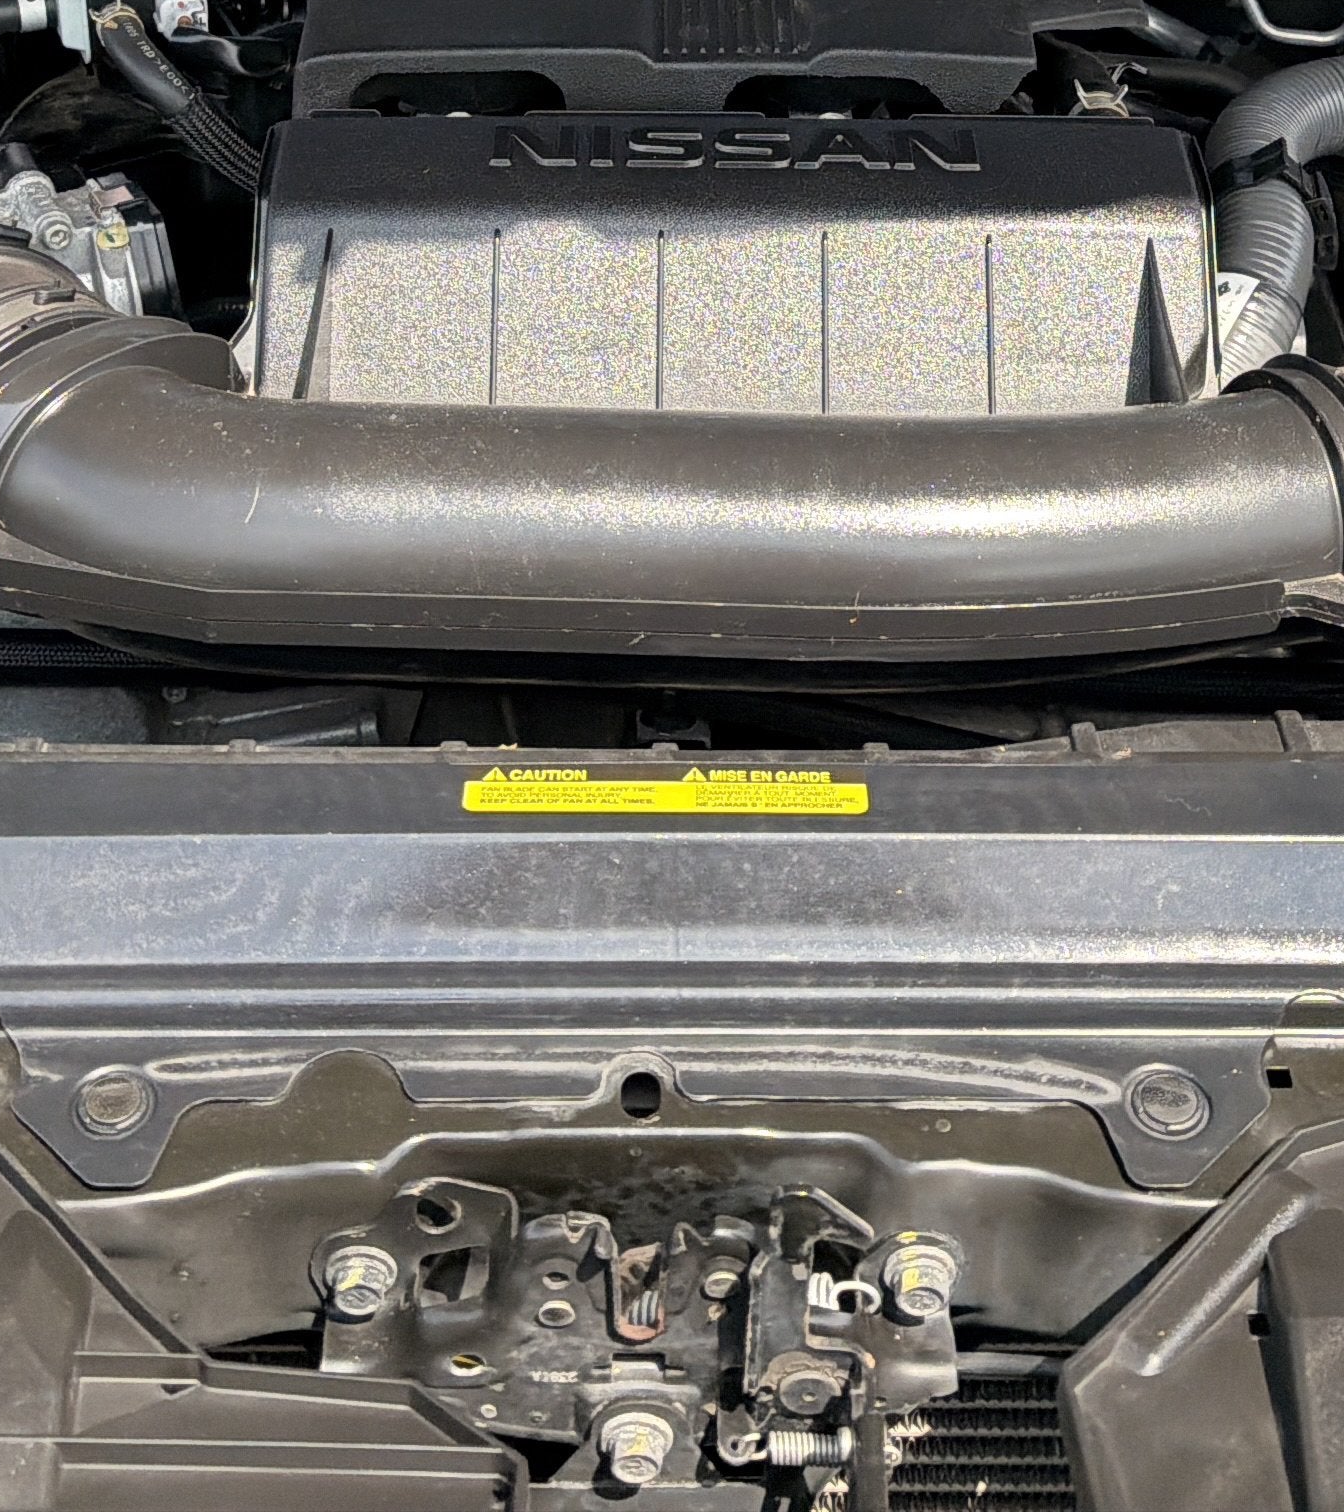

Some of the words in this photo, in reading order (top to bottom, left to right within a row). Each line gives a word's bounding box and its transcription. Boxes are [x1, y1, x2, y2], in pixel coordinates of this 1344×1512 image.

[488, 125, 982, 172] NISSAN
[509, 769, 588, 781] CAUTION
[709, 769, 748, 782] MISE
[750, 770, 773, 782] EN
[775, 770, 832, 783] GARDE
